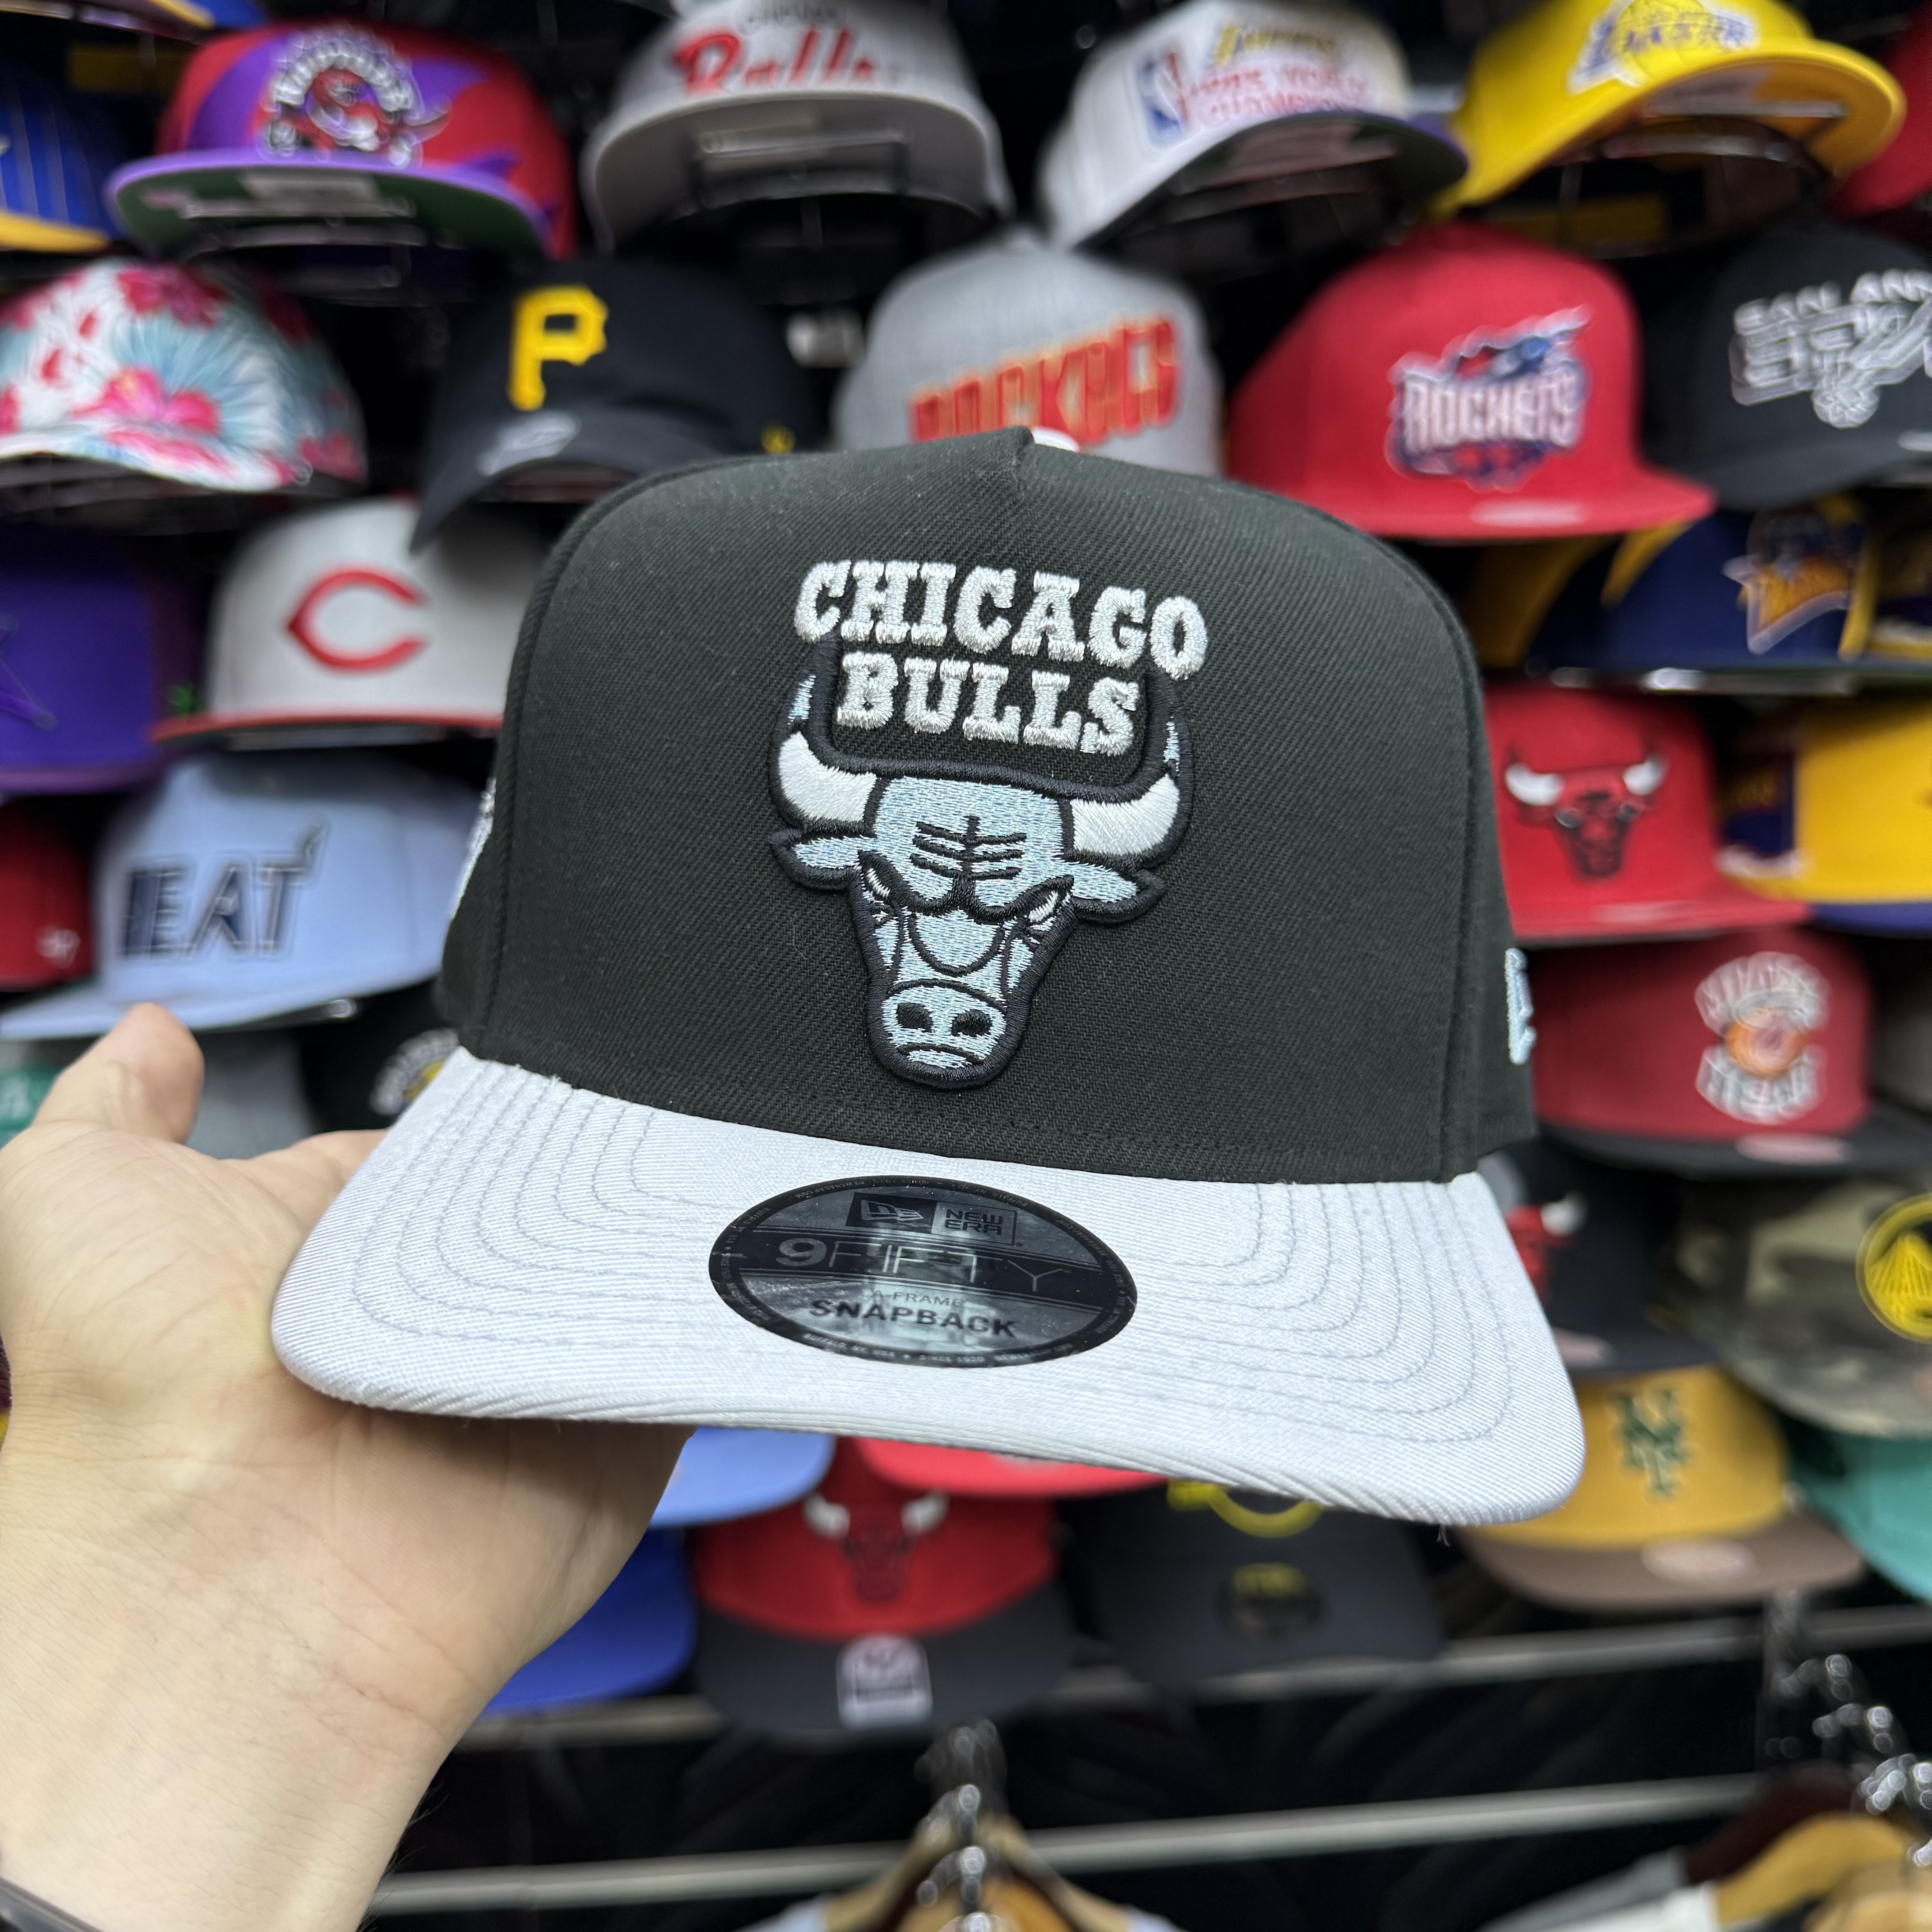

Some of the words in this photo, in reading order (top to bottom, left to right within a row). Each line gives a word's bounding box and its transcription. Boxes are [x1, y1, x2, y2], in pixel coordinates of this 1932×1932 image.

[508, 286, 607, 410] P
[288, 565, 426, 672] C
[794, 560, 1208, 680] CHICAGO
[837, 651, 1139, 757] BULLS
[945, 1219, 1003, 1235] ERA
[946, 1209, 1004, 1225] NEW
[776, 1237, 1063, 1292] 9FIFTY
[810, 1299, 1017, 1338] SNAPBACK
[871, 1289, 965, 1308] A-FRAME
